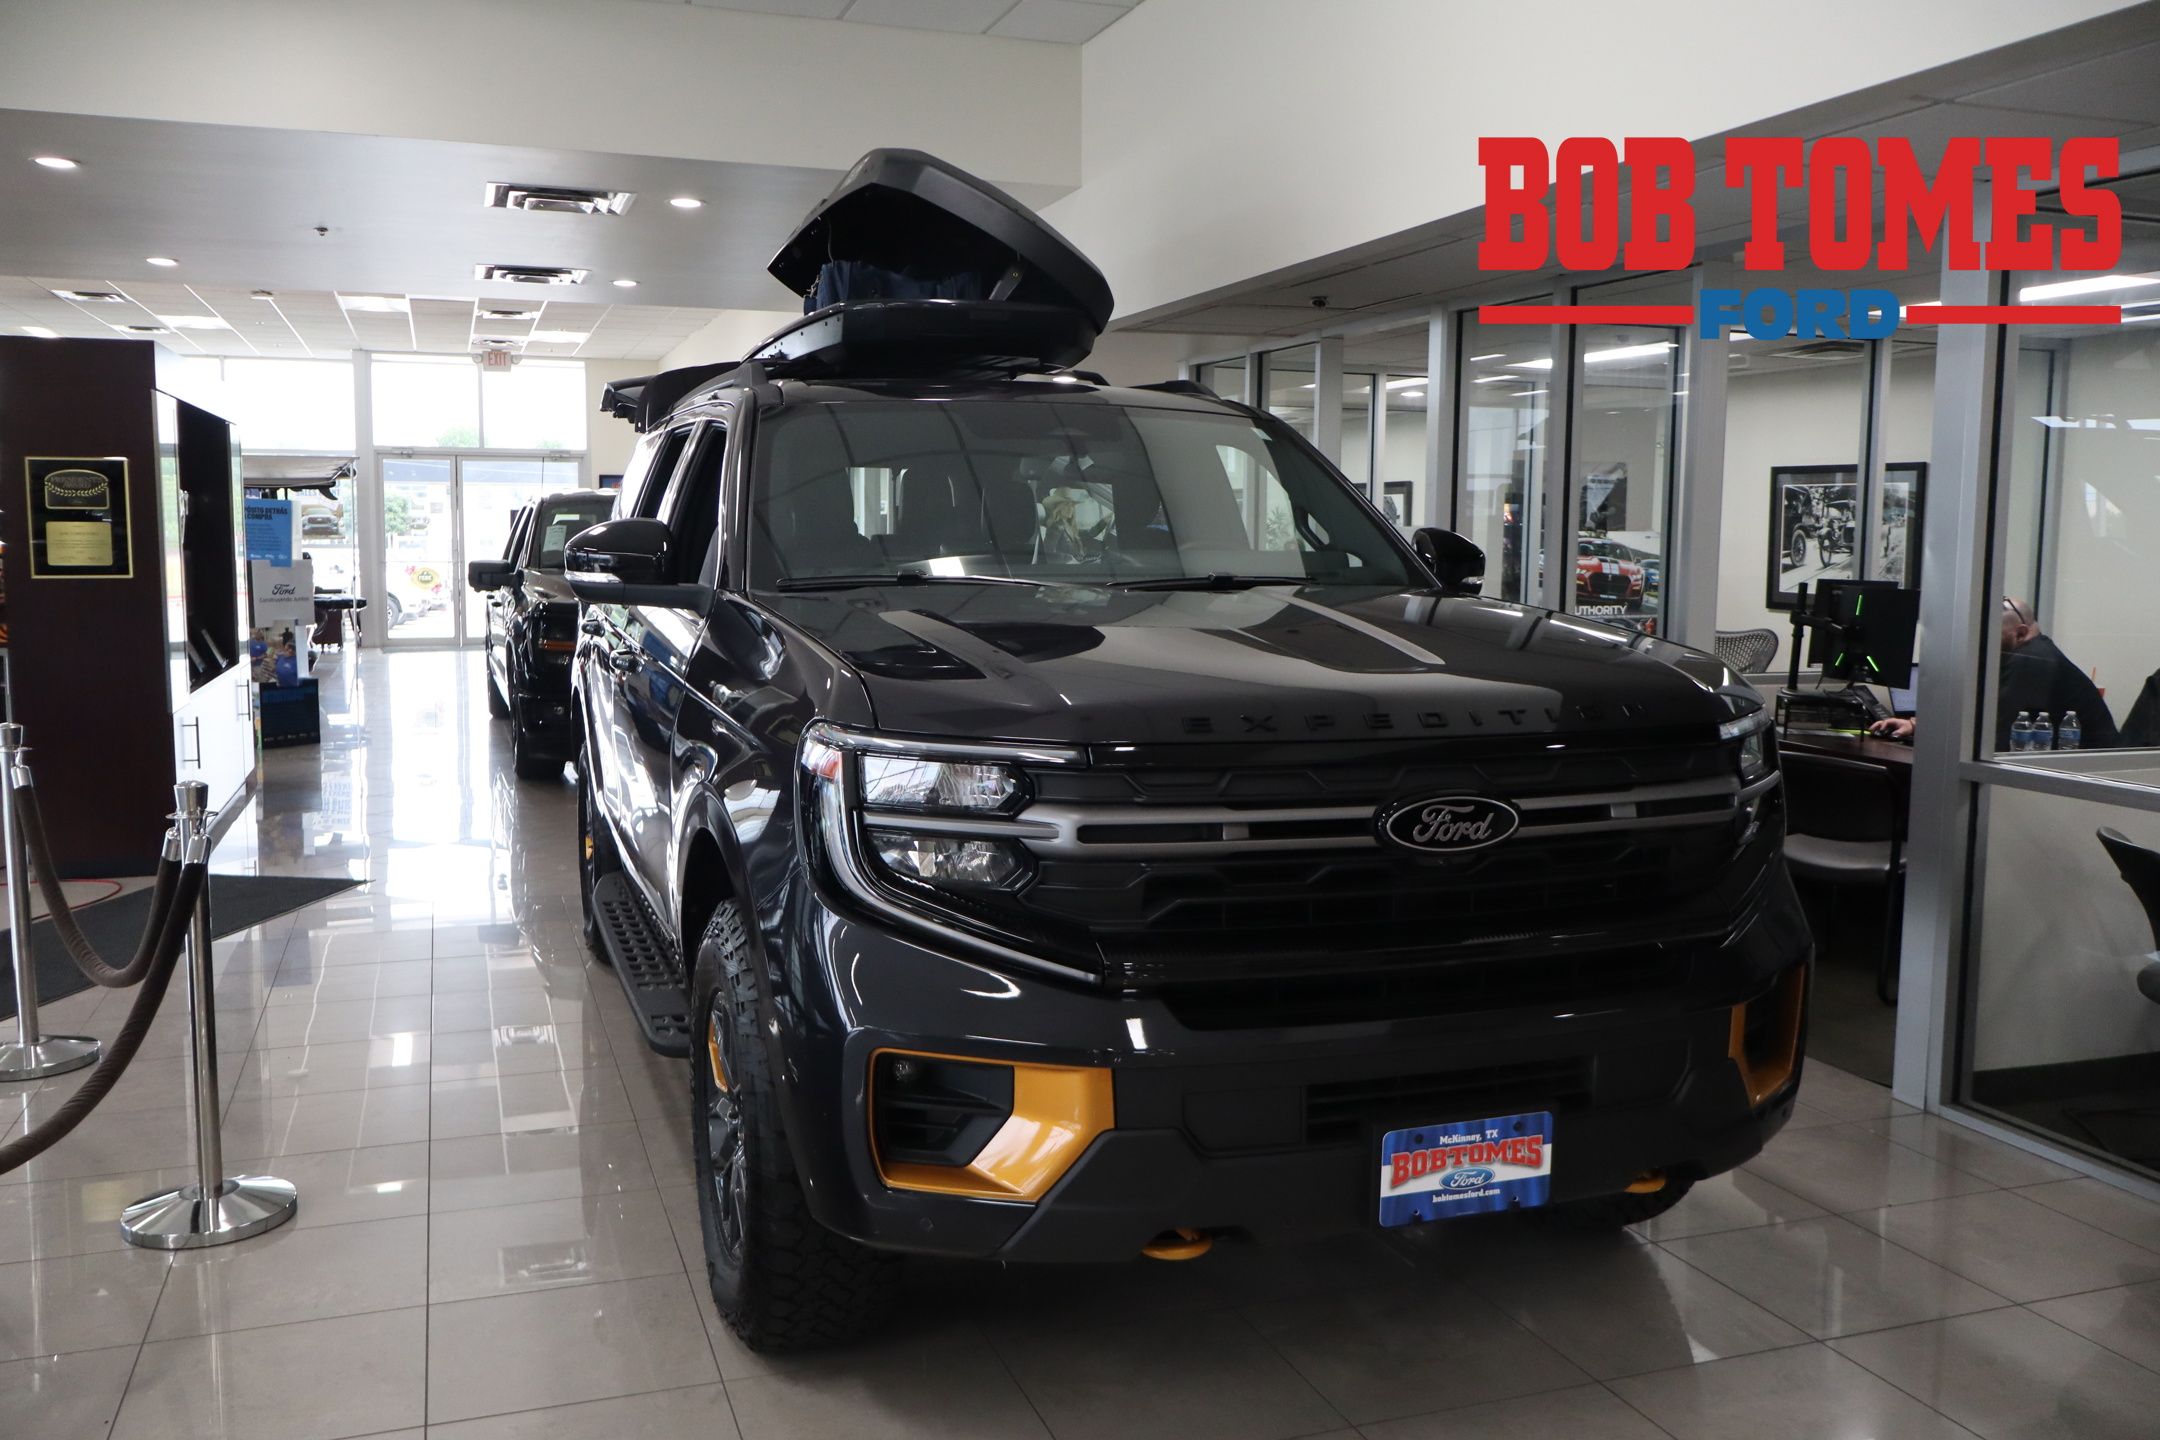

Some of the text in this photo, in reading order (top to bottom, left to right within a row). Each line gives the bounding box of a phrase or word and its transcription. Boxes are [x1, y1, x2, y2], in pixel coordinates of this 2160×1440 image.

[488, 352, 507, 366] EXIT
[272, 584, 296, 595] Ford
[1413, 805, 1495, 842] Ford
[1439, 1129, 1499, 1145] McKinney, TX
[1450, 1170, 1485, 1187] Ford
[1432, 1188, 1501, 1203] bobtomesford.com
